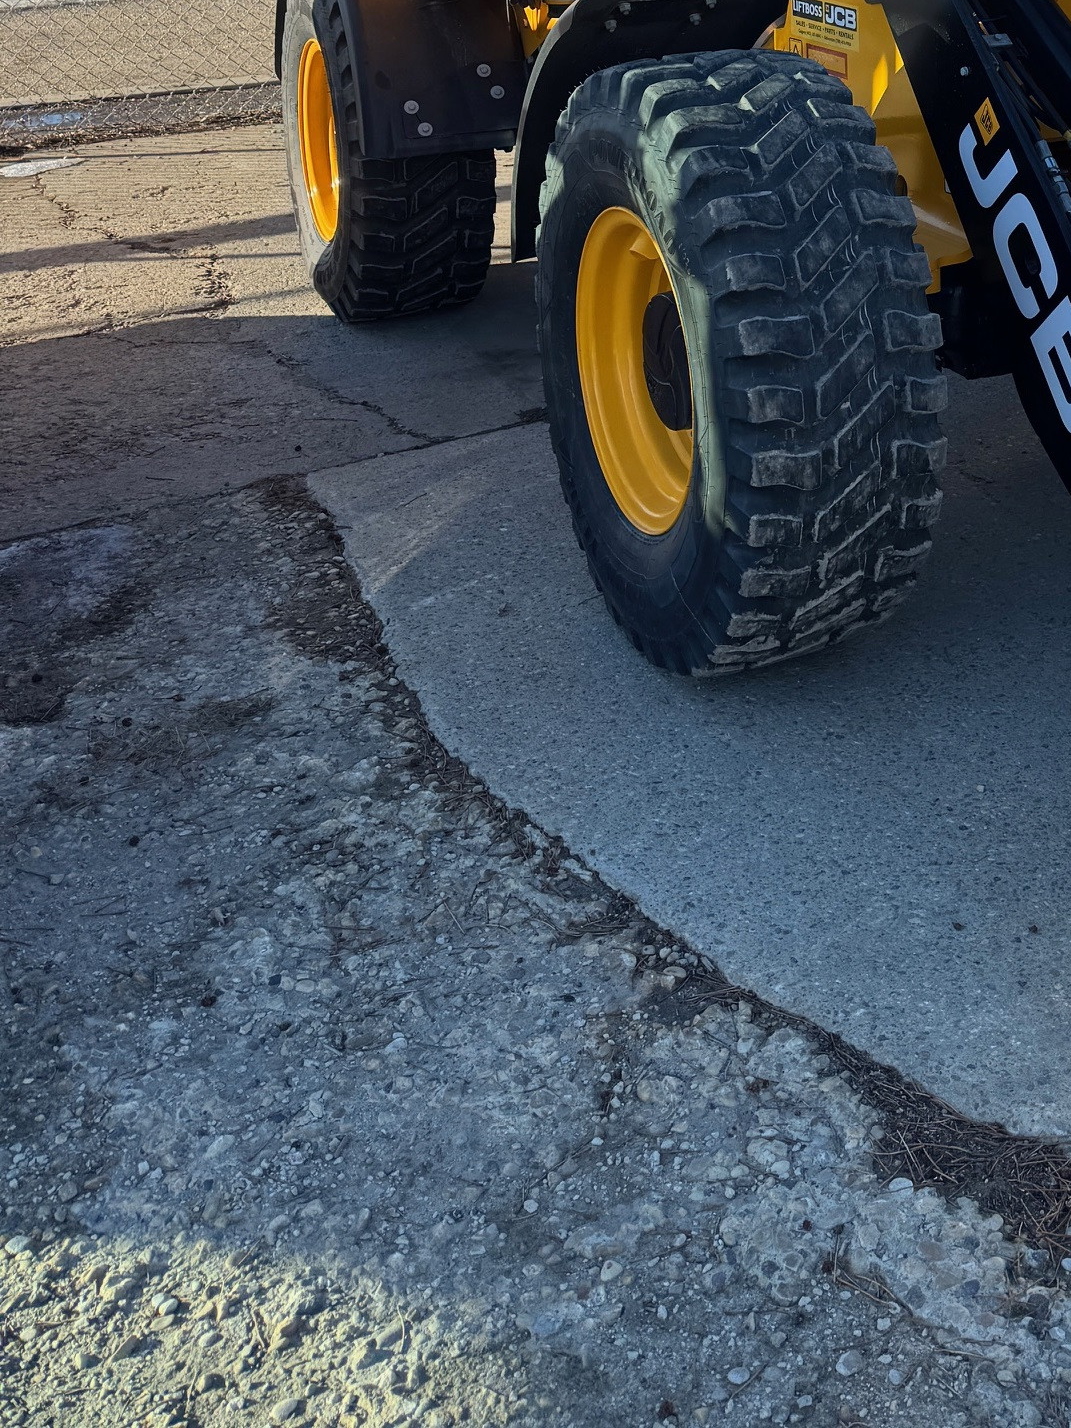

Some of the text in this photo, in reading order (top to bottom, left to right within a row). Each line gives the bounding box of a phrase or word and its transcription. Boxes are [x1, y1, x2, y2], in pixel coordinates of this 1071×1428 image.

[792, 0, 857, 30] LIFTBOSS JCB
[795, 20, 806, 28] SALES
[808, 23, 822, 31] SERVICE
[824, 27, 836, 35] PARTS
[838, 30, 854, 40] RENTALS
